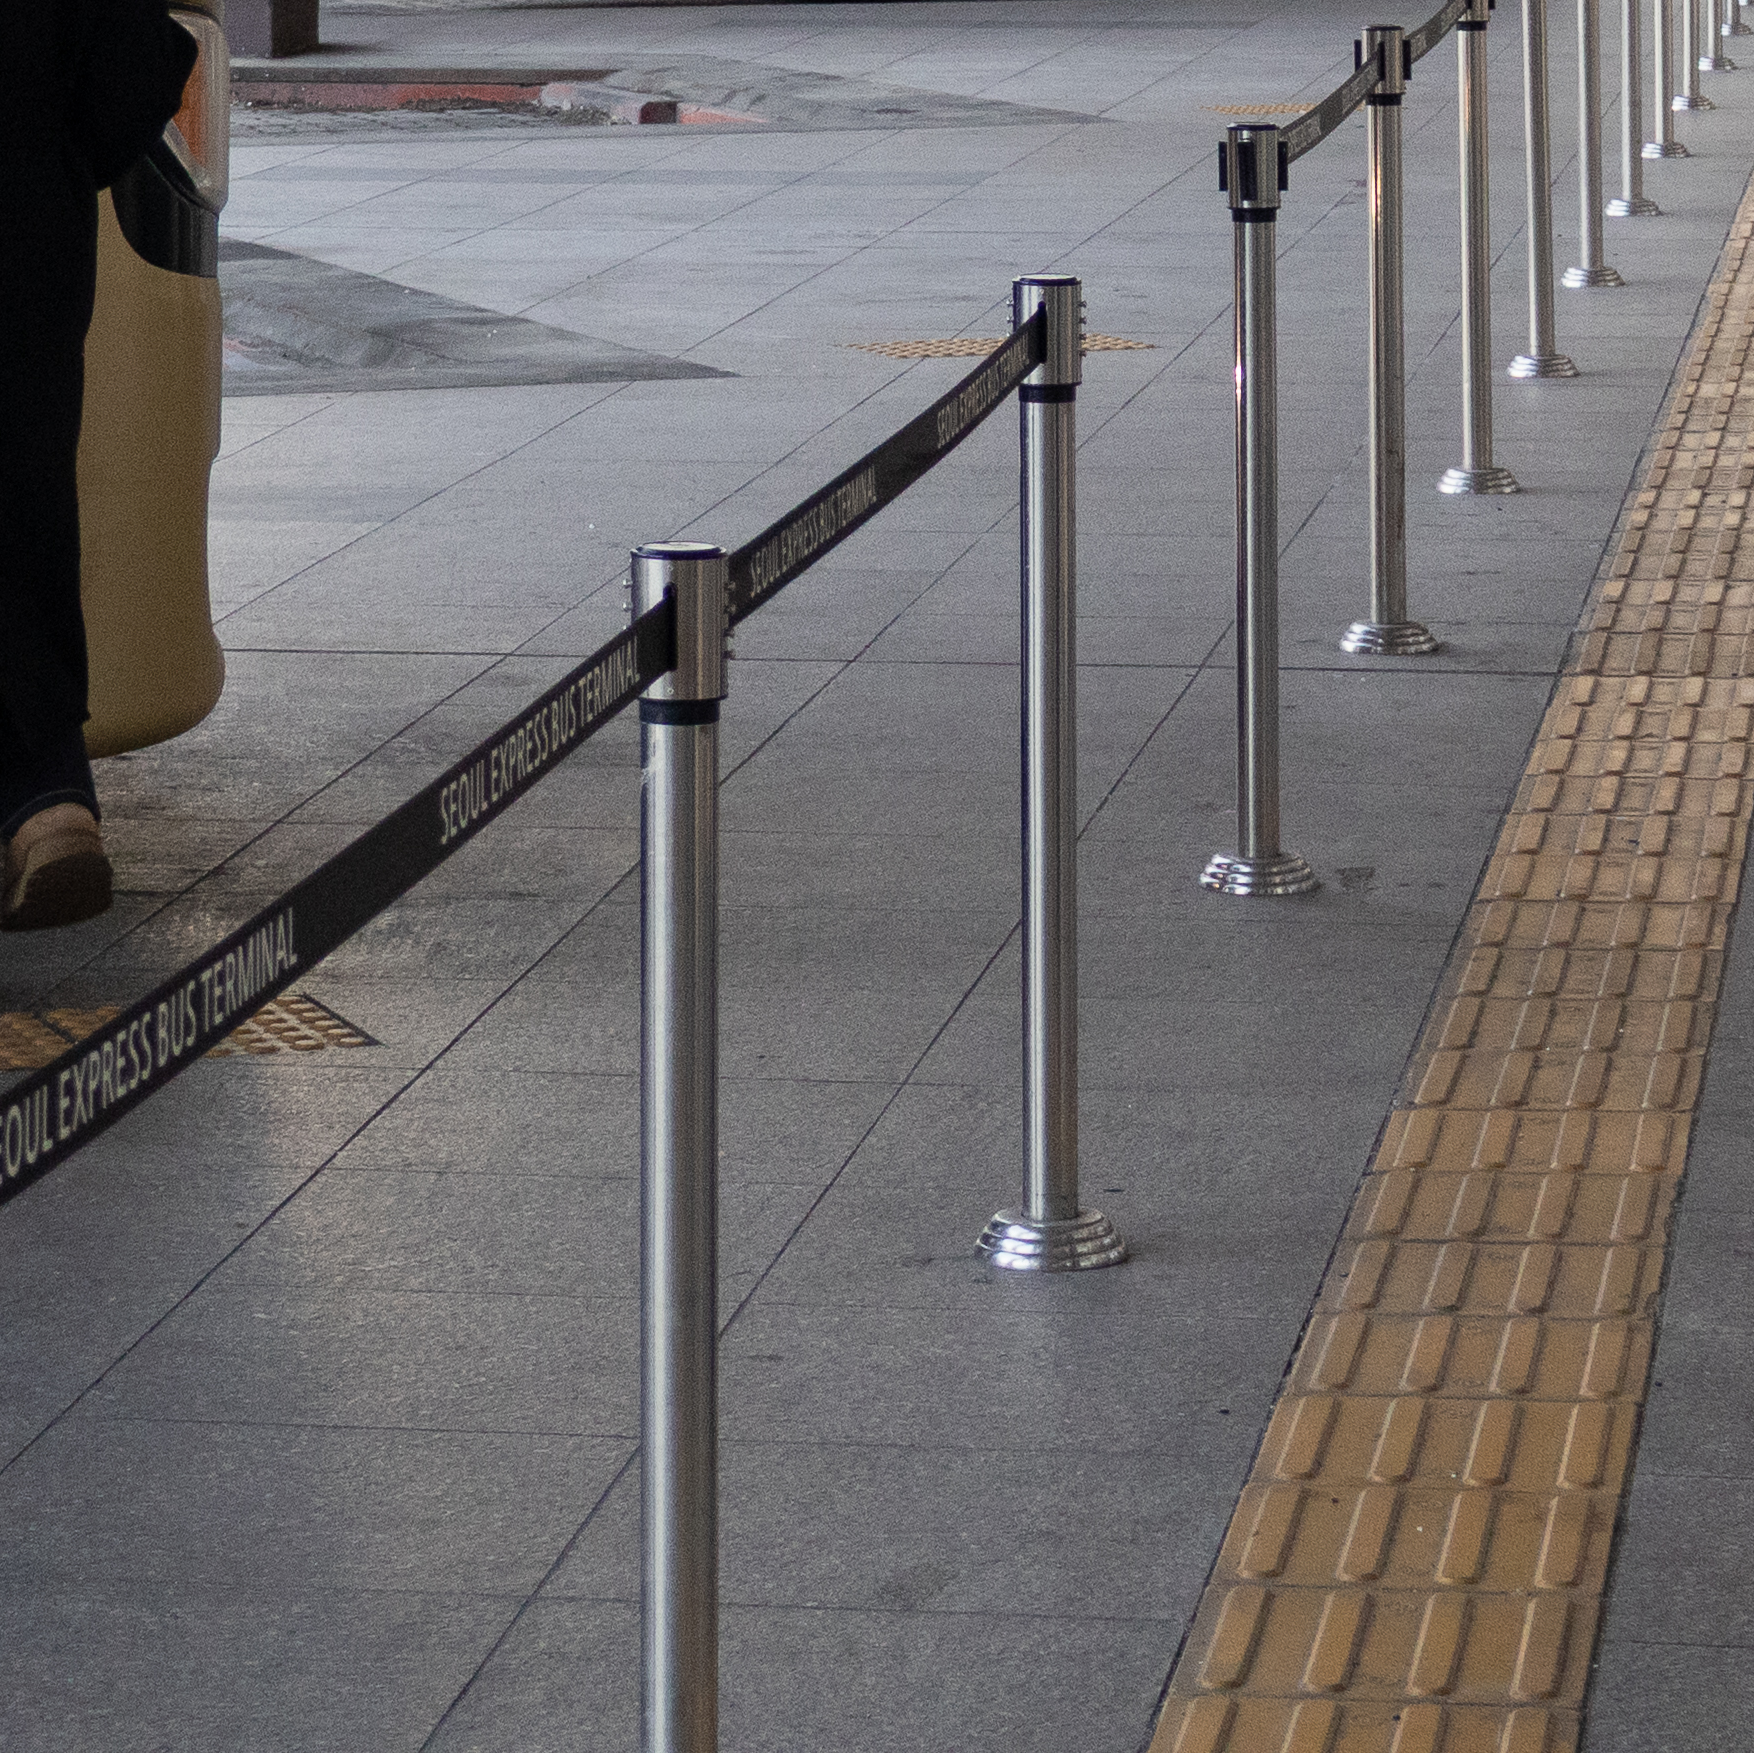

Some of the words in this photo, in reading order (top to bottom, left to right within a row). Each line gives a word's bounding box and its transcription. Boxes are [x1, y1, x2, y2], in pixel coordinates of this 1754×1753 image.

[440, 761, 488, 846] SEOUL
[490, 706, 549, 804] EXPRESS
[551, 685, 576, 751] BUS
[574, 636, 641, 729] TERMINAL
[57, 1013, 153, 1141] EXPRESS
[156, 981, 198, 1070] BUS
[200, 907, 299, 1033] TERMINAL
